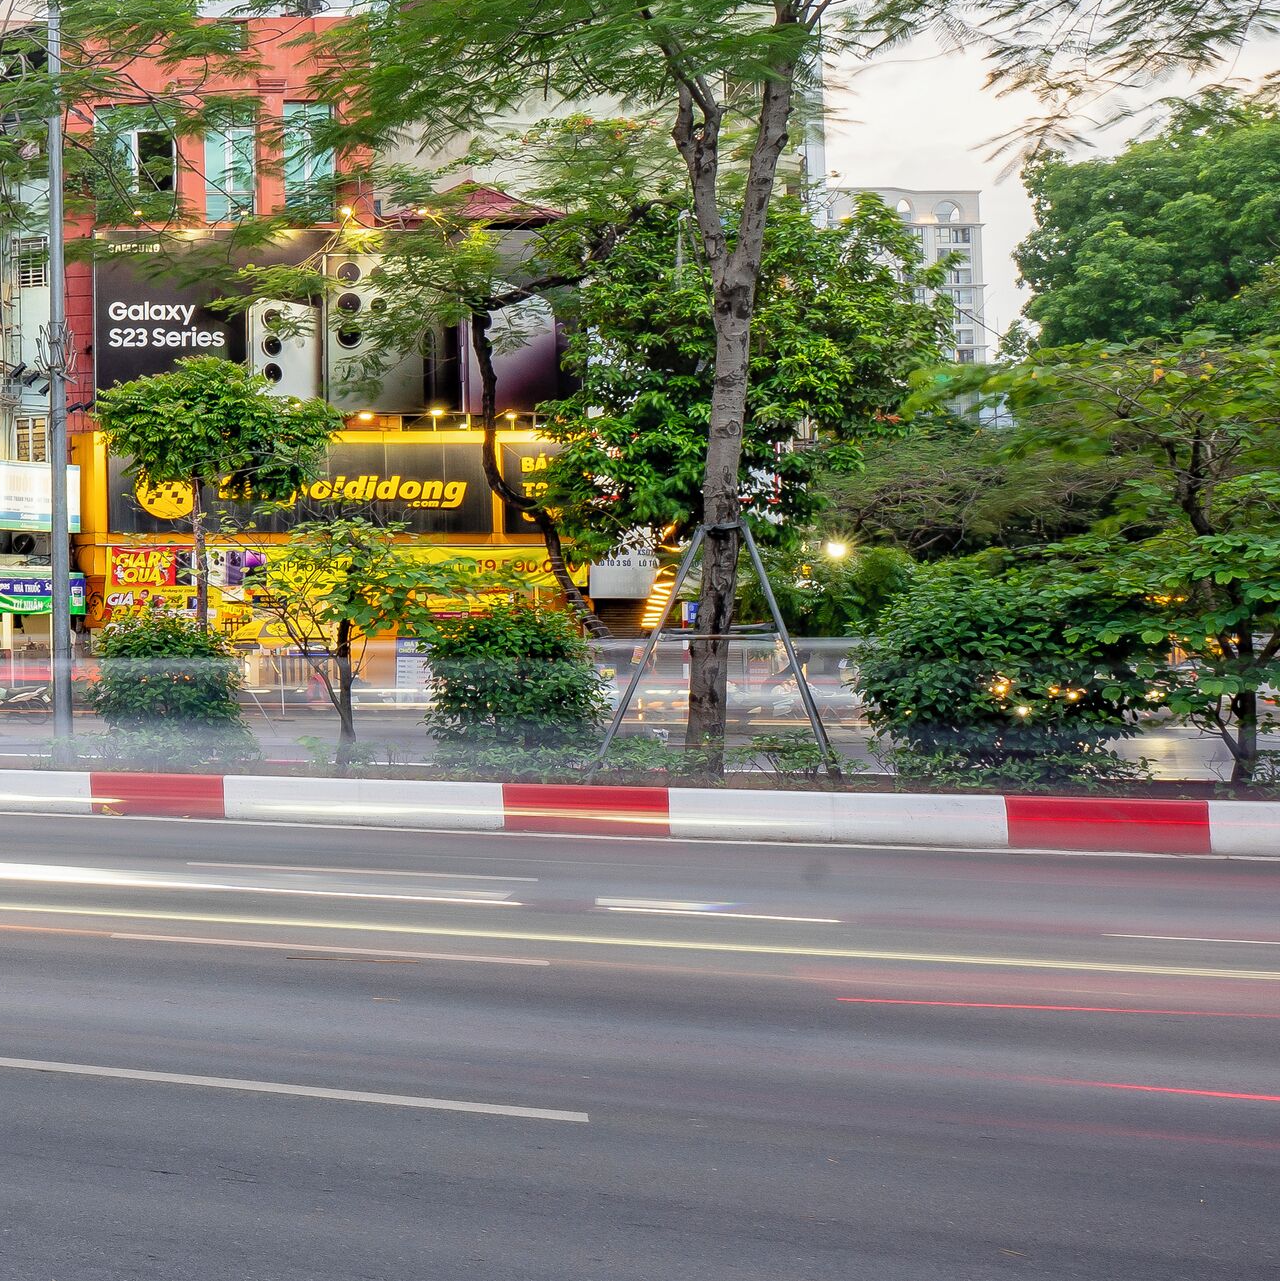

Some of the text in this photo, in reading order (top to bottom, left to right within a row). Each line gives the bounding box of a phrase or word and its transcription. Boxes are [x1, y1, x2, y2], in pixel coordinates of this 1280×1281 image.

[108, 243, 160, 253] SAMSUNG
[108, 301, 196, 326] Galaxy
[108, 326, 225, 348] S23 Series
[407, 500, 440, 508] .com
[616, 559, 621, 567] 3
[13, 581, 24, 593] NHÀ
[24, 581, 41, 593] THUỐC
[107, 591, 134, 606] GIÁ
